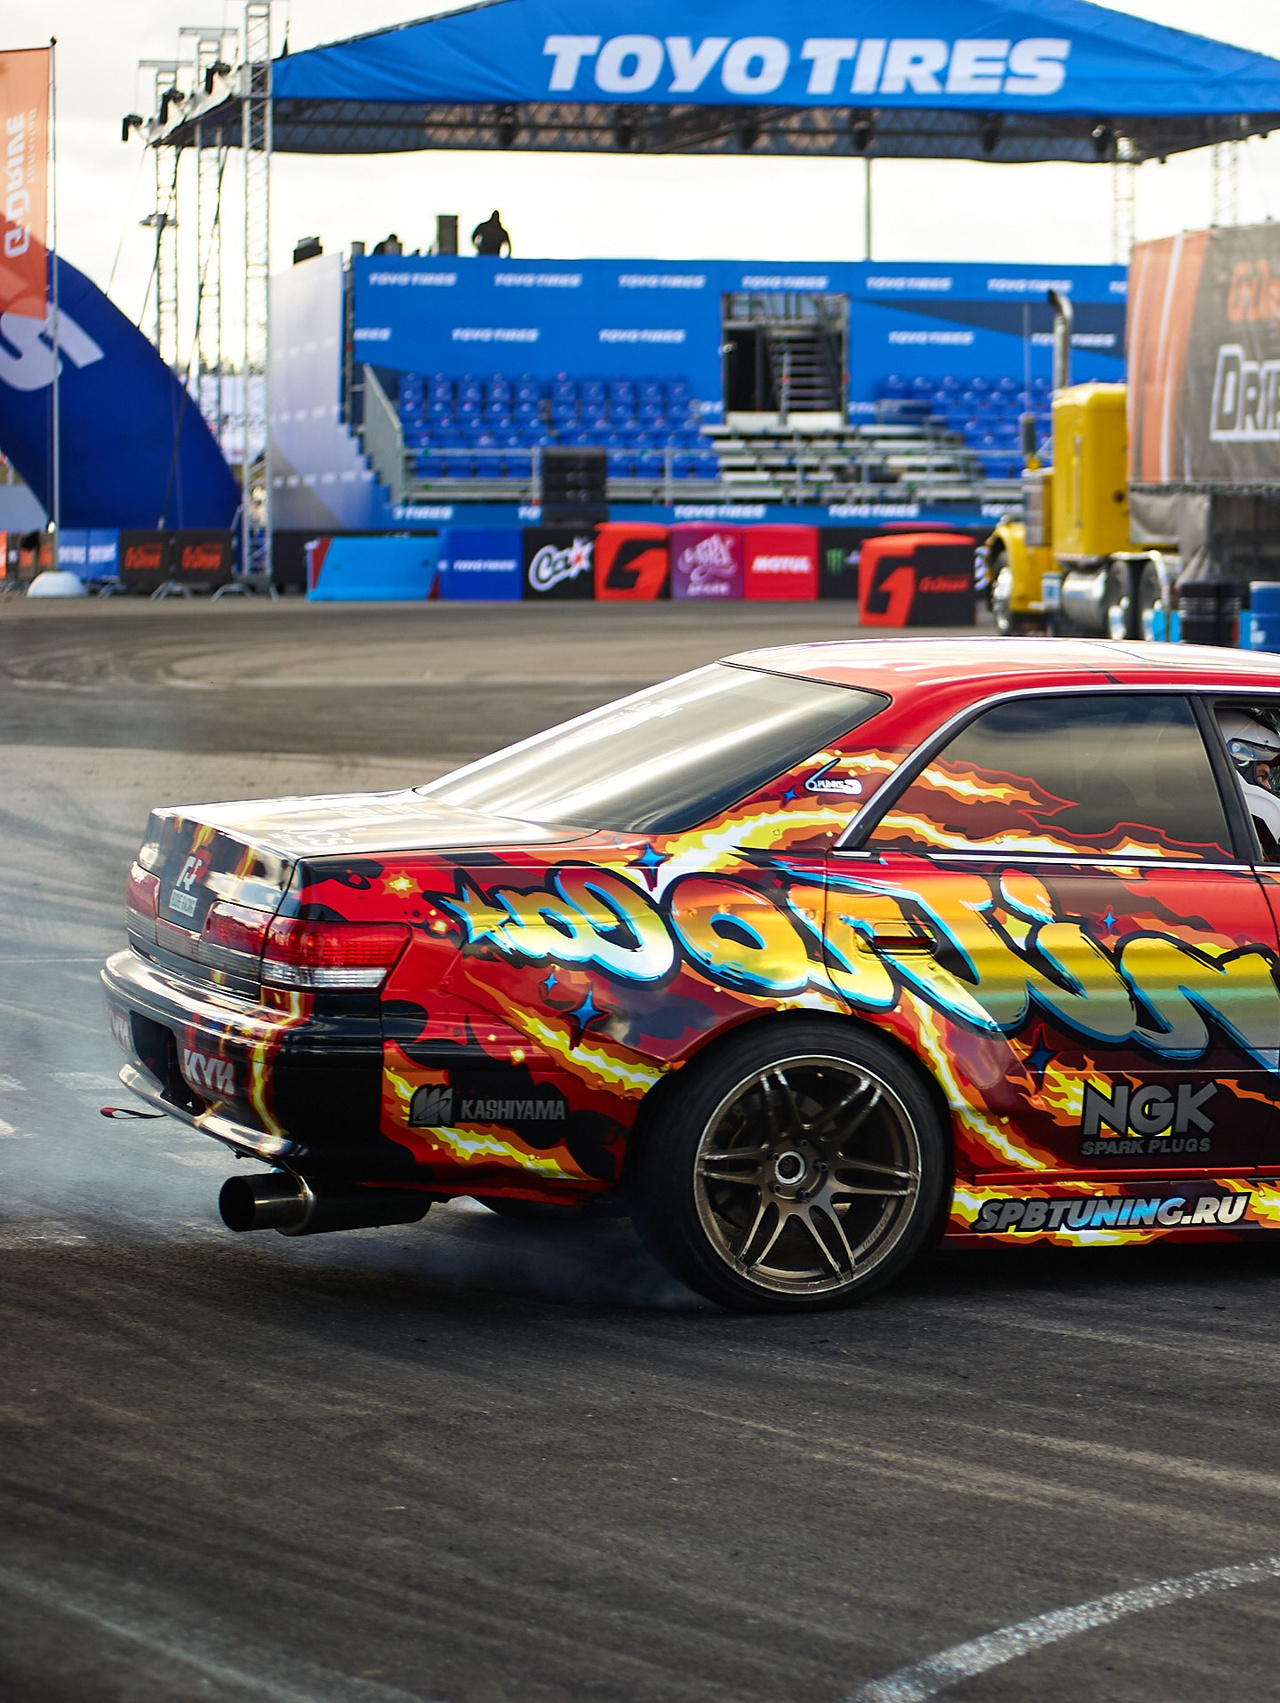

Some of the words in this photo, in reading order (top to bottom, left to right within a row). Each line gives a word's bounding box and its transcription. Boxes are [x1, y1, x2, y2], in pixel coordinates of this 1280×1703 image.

[543, 34, 790, 94] TOYO
[801, 39, 1070, 95] TIRES
[460, 1099, 566, 1121] KASHIYAMA
[1083, 1081, 1219, 1135] NGK
[1080, 1140, 1144, 1156] SPARK
[1147, 1137, 1213, 1154] PLUGS
[976, 1195, 1248, 1232] SPBTUNING.RU
